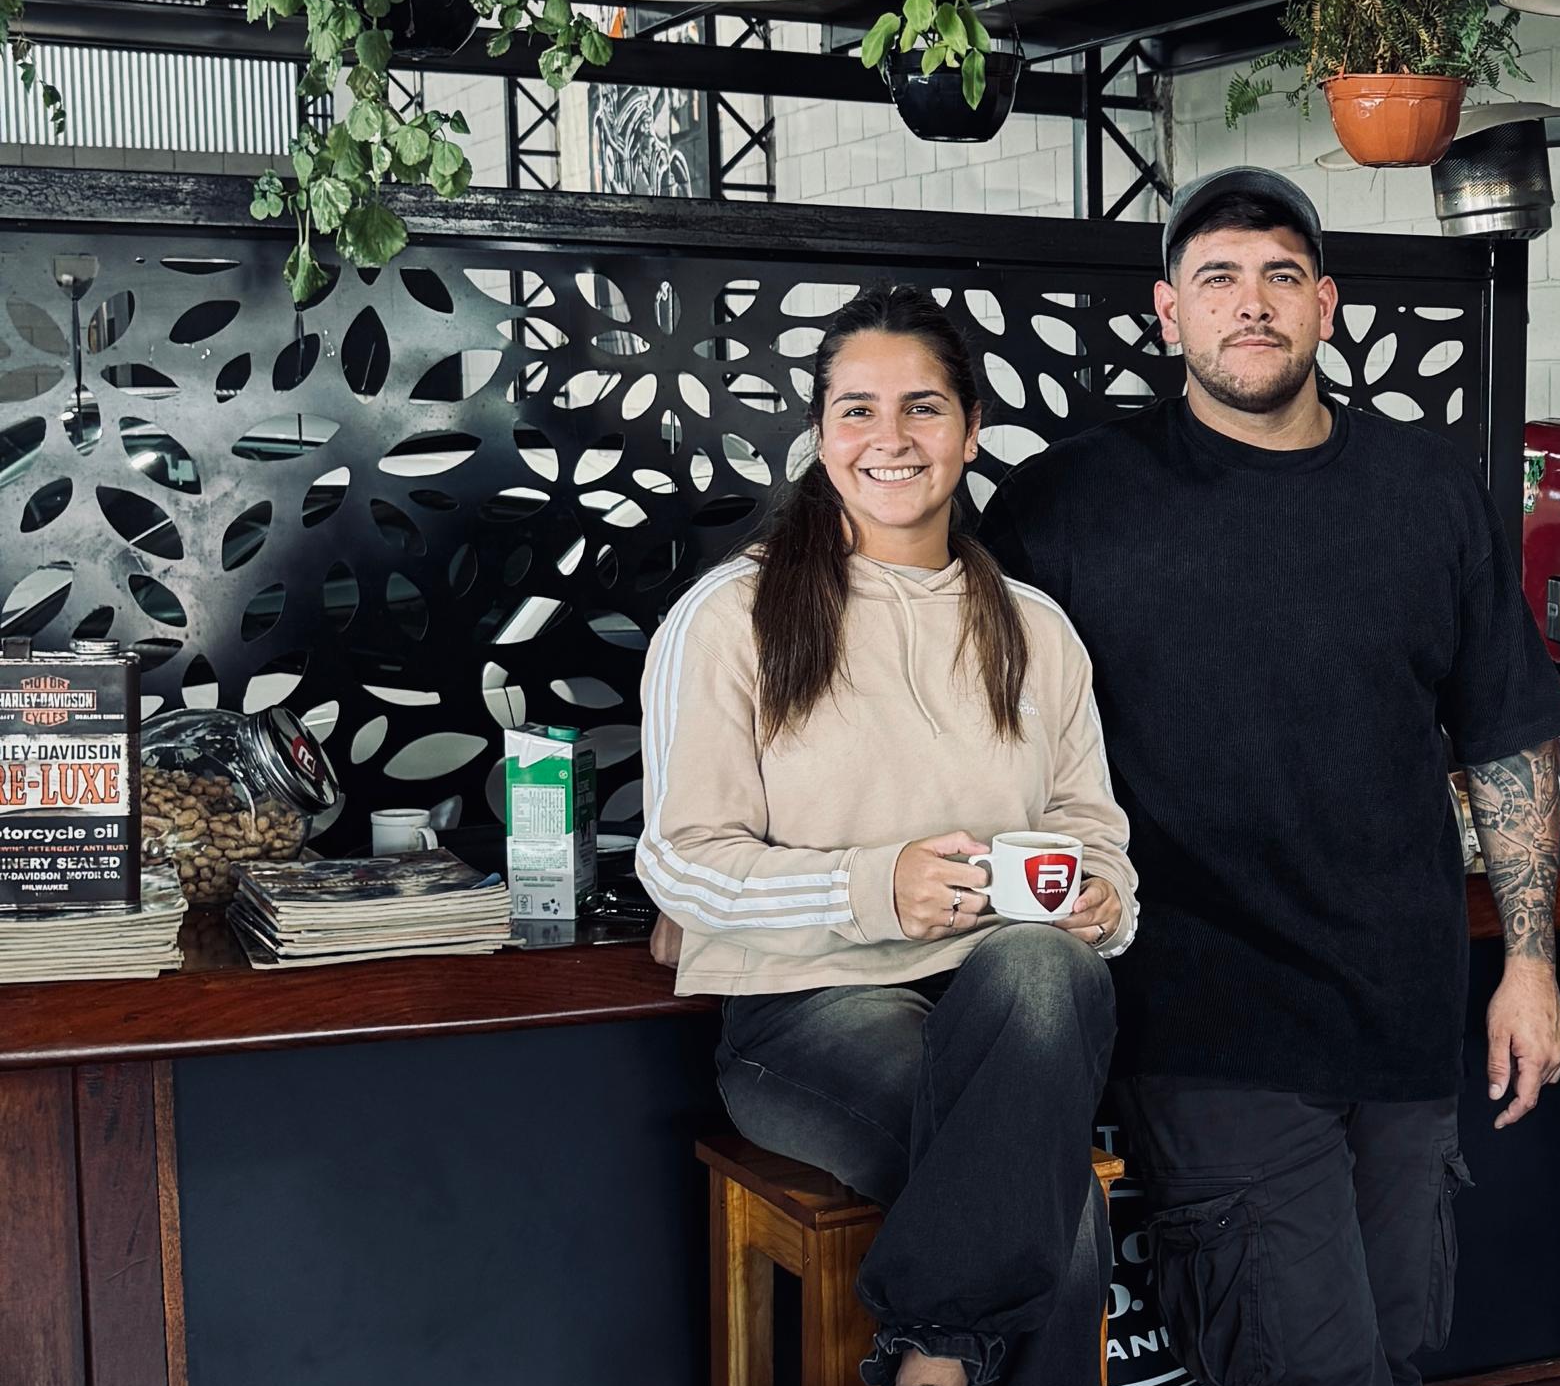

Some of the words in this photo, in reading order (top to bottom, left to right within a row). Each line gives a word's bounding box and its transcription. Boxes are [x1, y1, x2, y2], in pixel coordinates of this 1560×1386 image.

[24, 676, 66, 689] MOTOR
[25, 712, 67, 726] CYCLES
[93, 823, 119, 838] oil
[56, 856, 121, 869] SEALED
[66, 871, 101, 880] MOTOR
[1037, 864, 1069, 888] R
